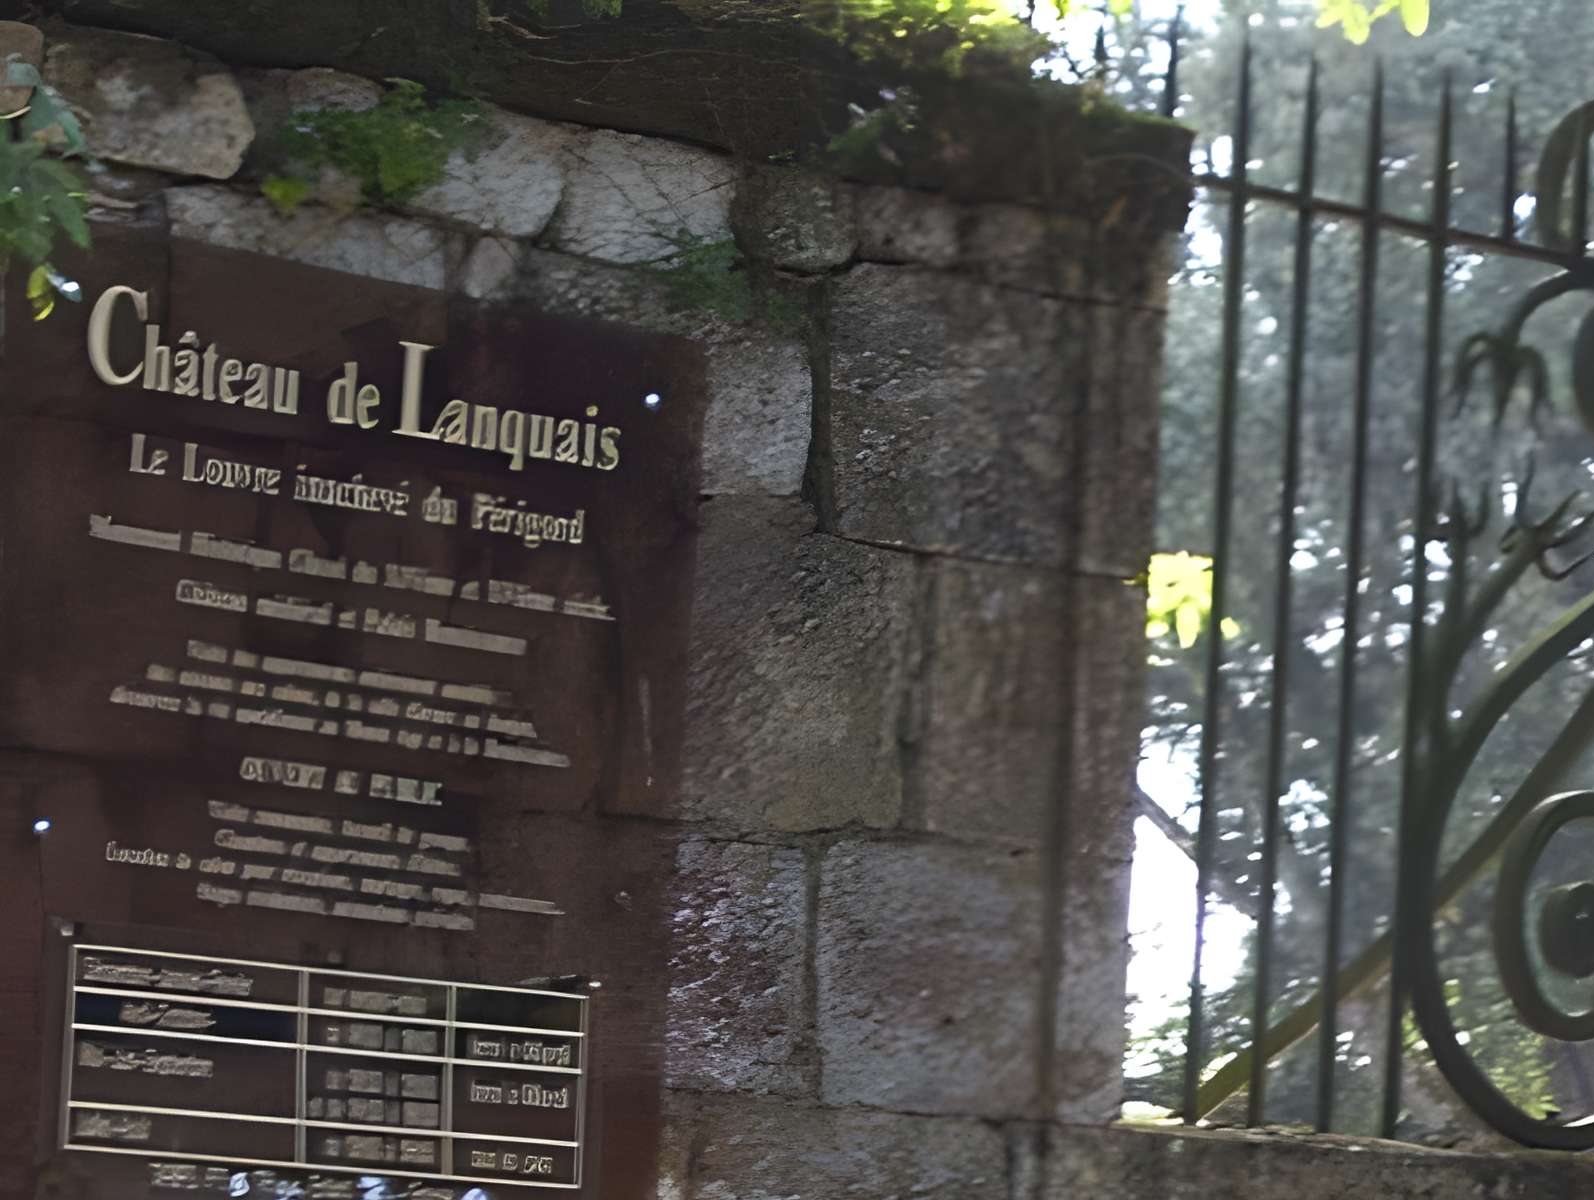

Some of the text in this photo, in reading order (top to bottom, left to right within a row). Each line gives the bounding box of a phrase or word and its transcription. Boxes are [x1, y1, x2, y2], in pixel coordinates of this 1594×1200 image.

[87, 284, 622, 471] Château de Lanquais
[129, 433, 169, 475] Le
[472, 493, 586, 549] Périgord
